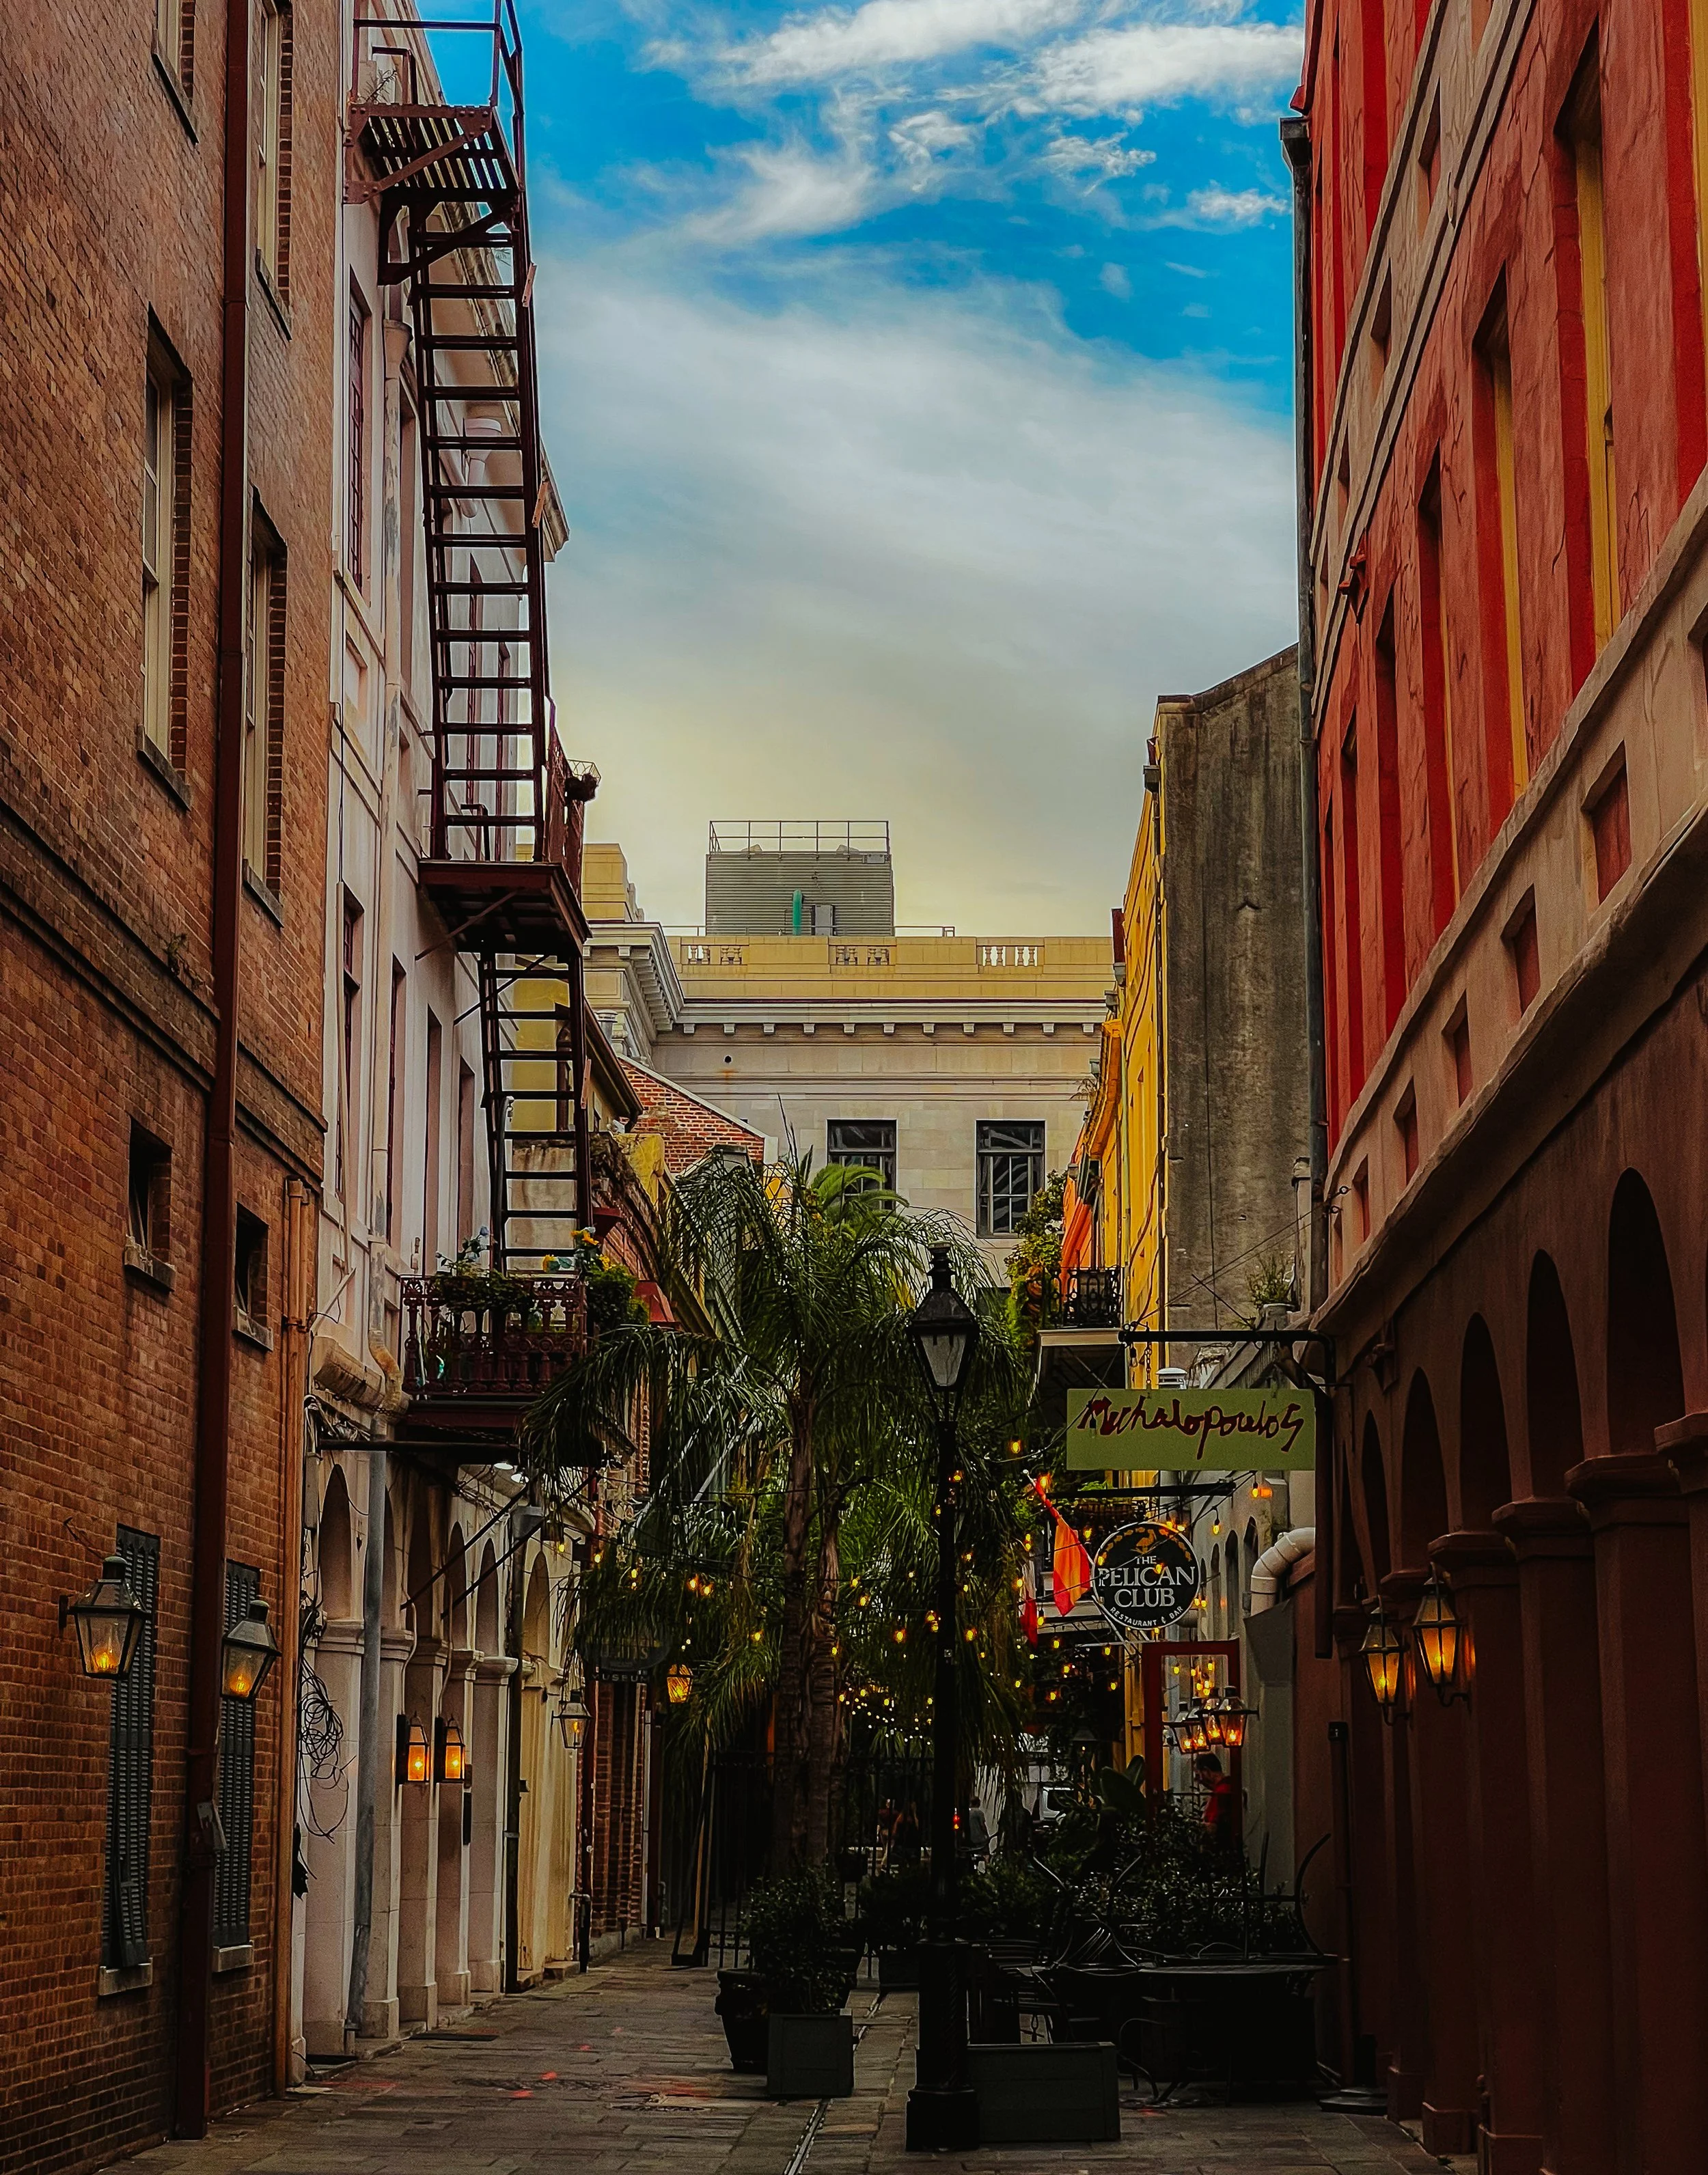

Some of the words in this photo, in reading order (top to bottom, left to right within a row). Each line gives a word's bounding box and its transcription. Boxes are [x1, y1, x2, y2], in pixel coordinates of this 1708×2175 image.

[1135, 1555, 1157, 1564] THE
[1097, 1566, 1196, 1587] PELICAN
[1114, 1588, 1175, 1607] CLUB
[1110, 1607, 1157, 1627] RESTAURANT
[1169, 1606, 1183, 1619] BAR
